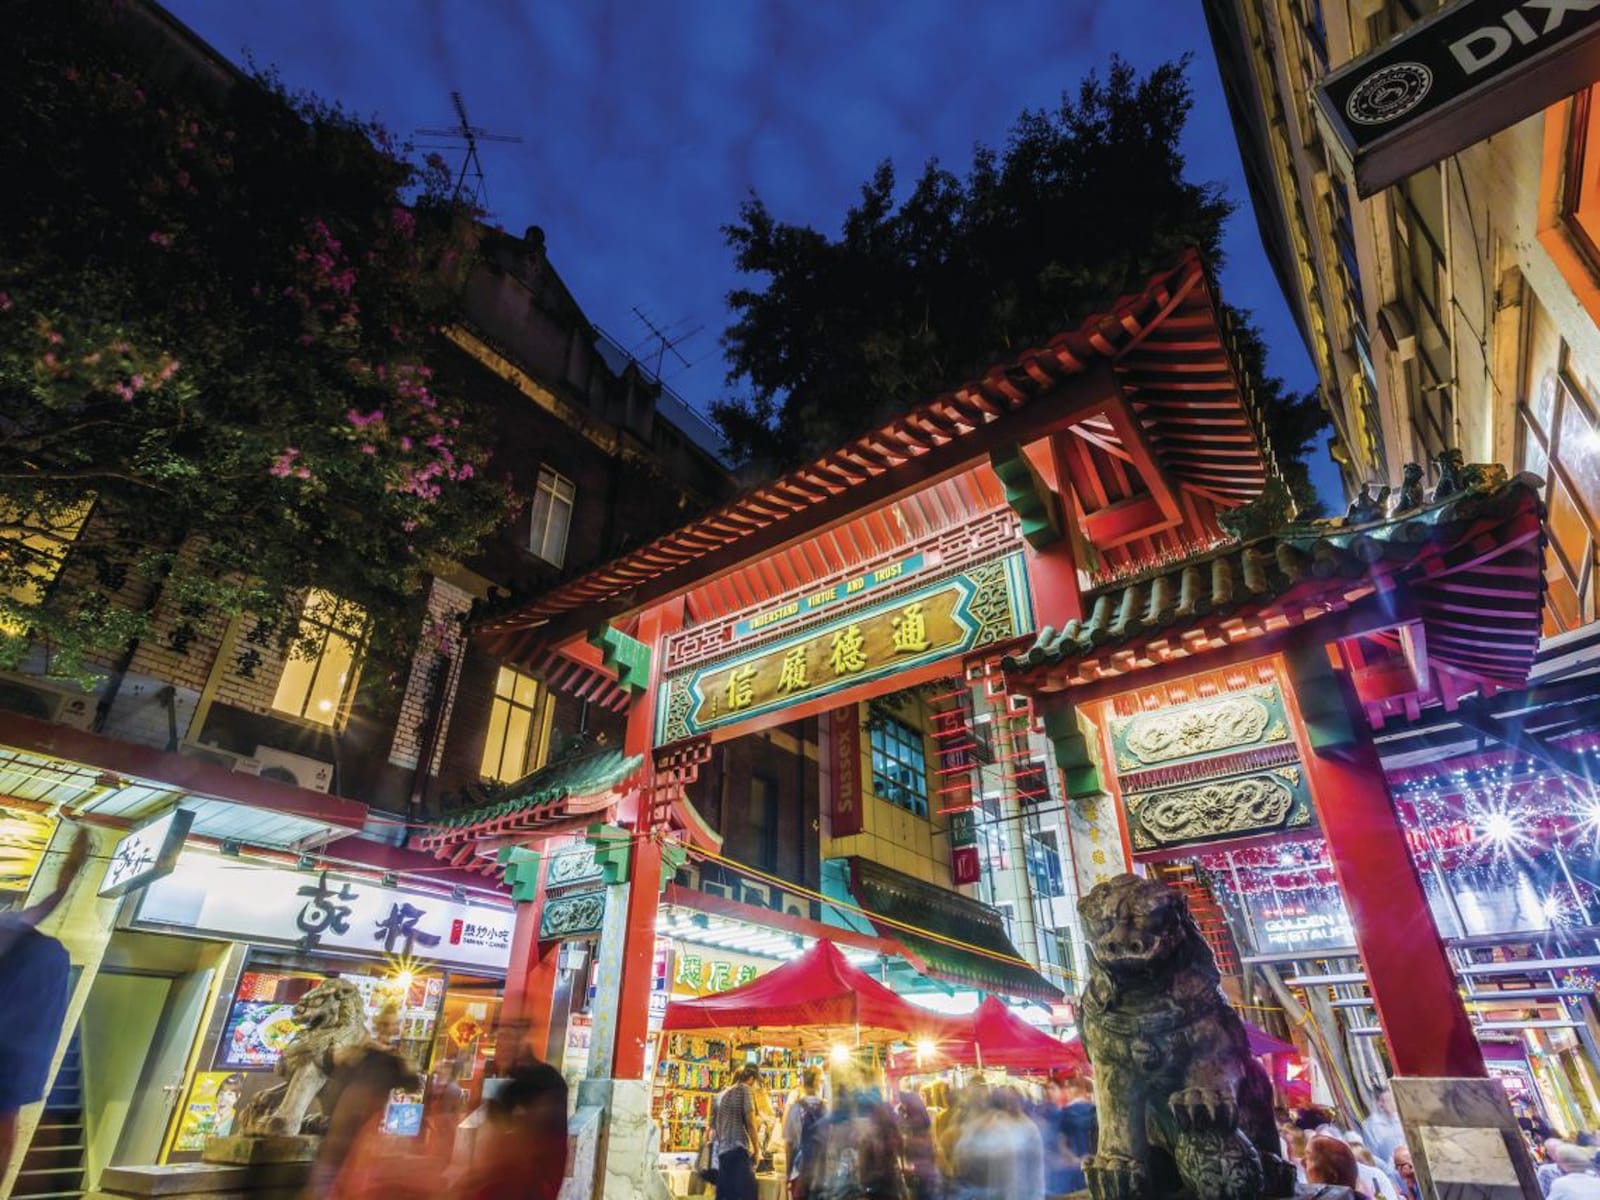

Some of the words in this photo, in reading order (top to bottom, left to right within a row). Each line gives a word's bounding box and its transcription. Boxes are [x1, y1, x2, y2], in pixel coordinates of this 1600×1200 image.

[1448, 0, 1600, 75] DIX
[807, 588, 837, 607] VIRTUE
[846, 577, 865, 593] AND
[874, 563, 903, 583] TRUST
[837, 729, 853, 813] Sussex
[1264, 914, 1335, 933] GOLDEN
